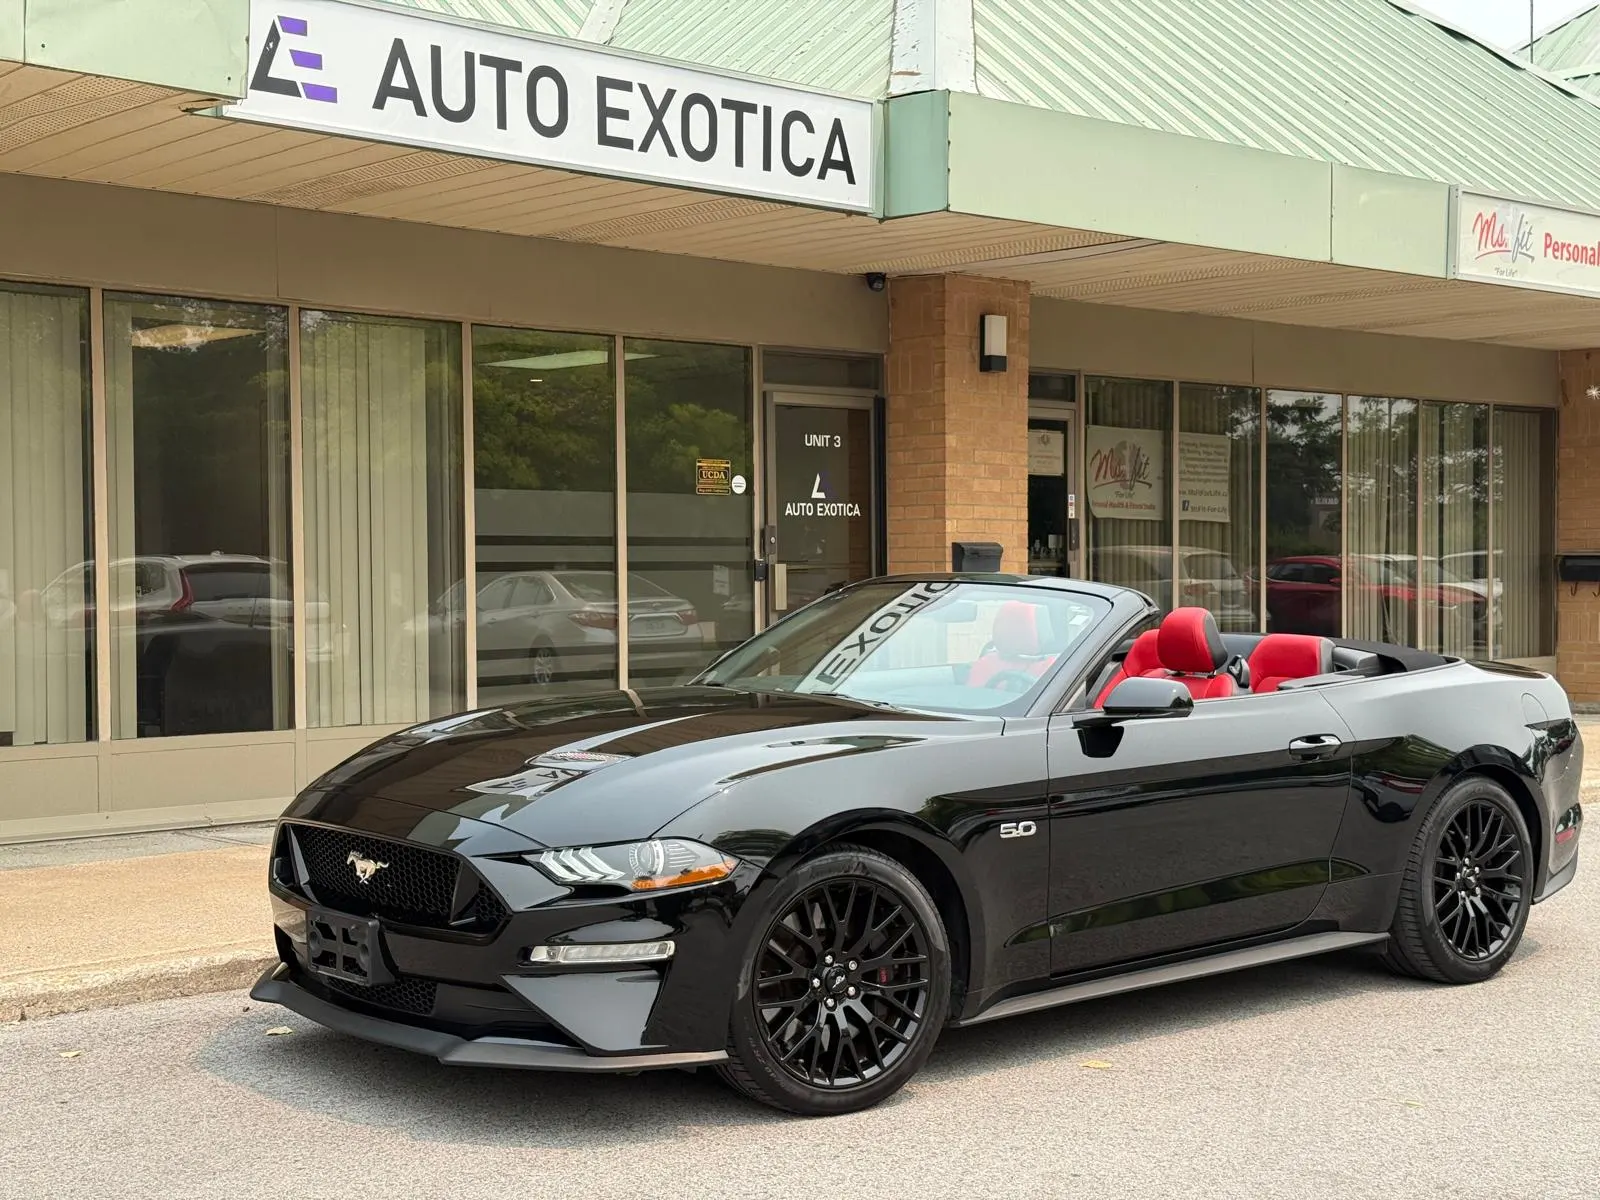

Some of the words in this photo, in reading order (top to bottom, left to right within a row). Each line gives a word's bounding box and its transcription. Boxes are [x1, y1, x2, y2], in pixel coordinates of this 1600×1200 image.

[372, 38, 569, 138] AUTO
[597, 76, 856, 186] EXOTICA
[804, 434, 831, 447] UNIT
[833, 435, 841, 447] 3
[702, 470, 725, 479] UCDA
[784, 502, 814, 516] AUTO
[817, 503, 861, 517] EXOTICA
[1000, 820, 1037, 839] 5.0
